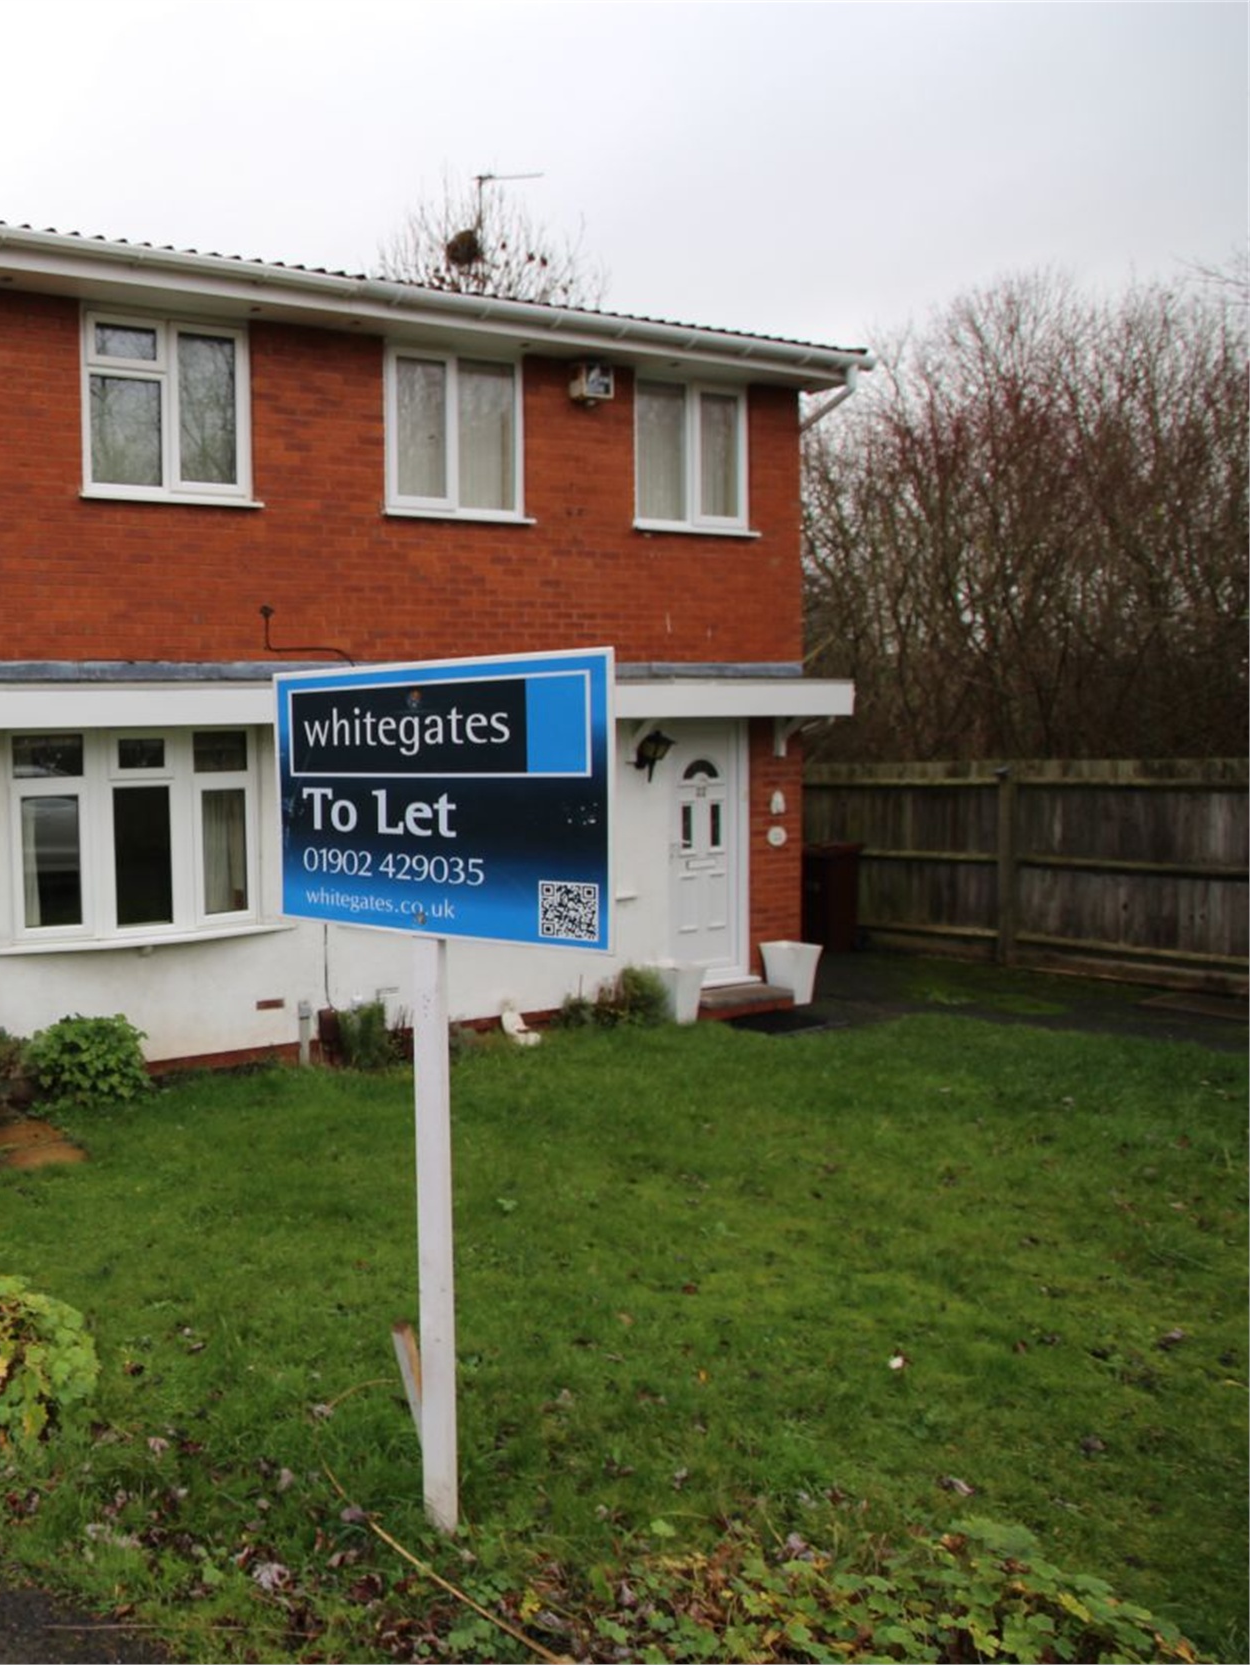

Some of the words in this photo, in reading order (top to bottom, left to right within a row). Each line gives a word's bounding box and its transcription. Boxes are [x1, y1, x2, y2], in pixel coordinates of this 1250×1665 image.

[303, 706, 511, 756] whitegates
[302, 787, 358, 833] To
[371, 789, 457, 838] Let
[303, 847, 372, 877] 01902
[379, 853, 485, 886] 429035
[306, 887, 456, 919] whitegates.co.uk
